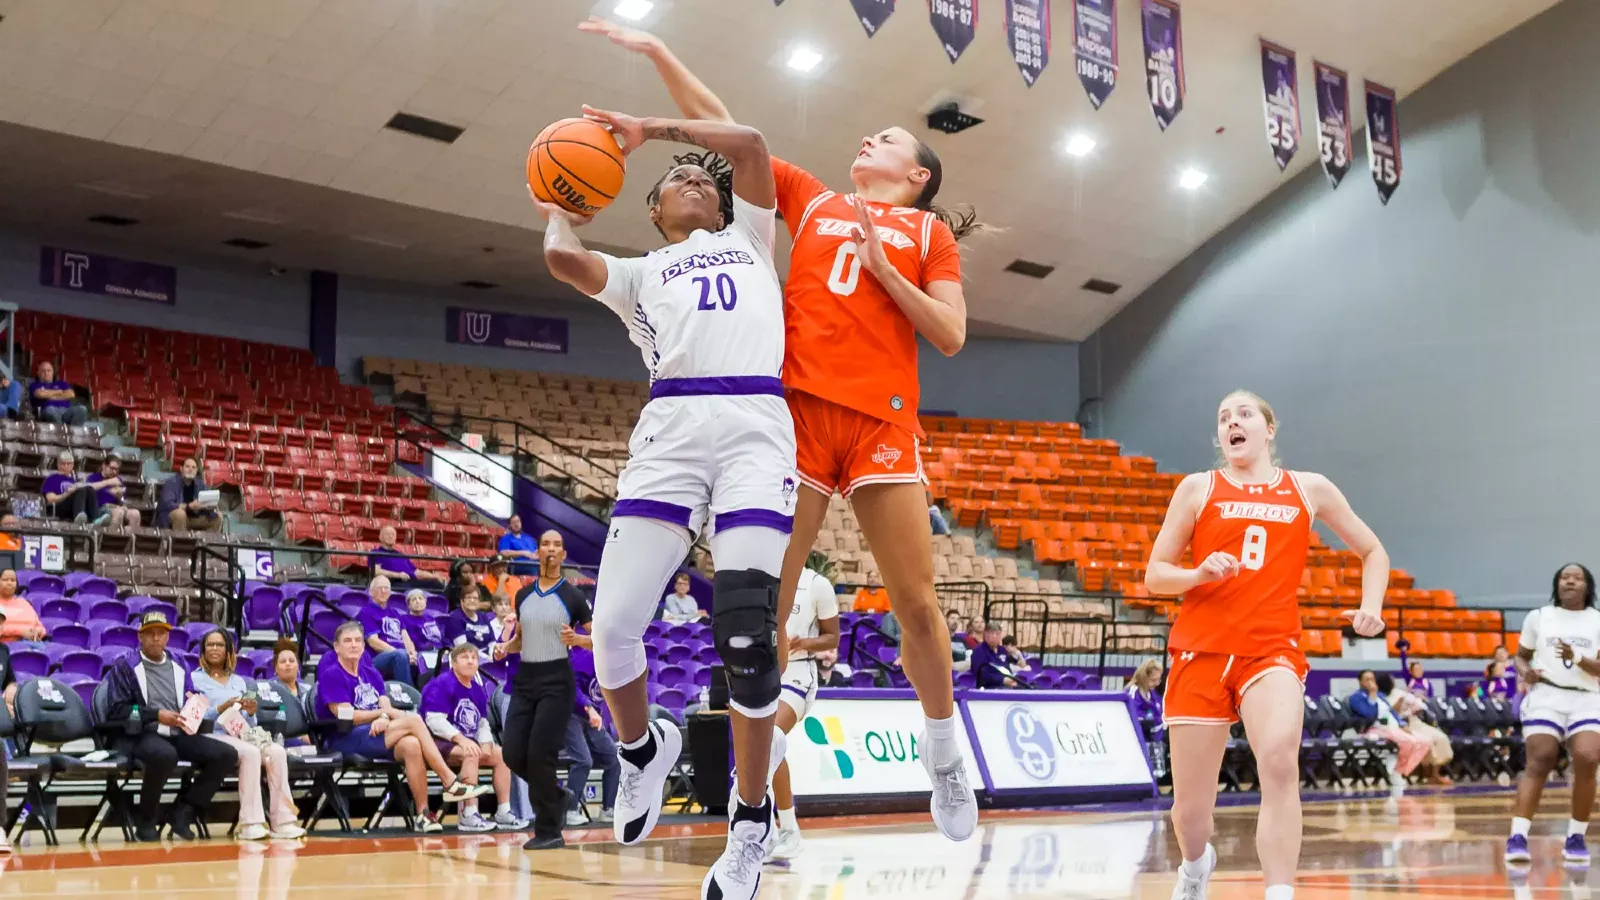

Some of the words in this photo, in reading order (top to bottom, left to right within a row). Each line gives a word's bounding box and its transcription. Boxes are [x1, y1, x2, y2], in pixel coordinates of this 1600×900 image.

[1150, 74, 1177, 109] 10
[1266, 116, 1295, 150] 25
[64, 252, 90, 288] T
[660, 250, 754, 287] DEMONS
[827, 240, 862, 297] 0
[691, 272, 738, 312] 20
[465, 312, 491, 343] U
[1214, 501, 1300, 524] UTRGV
[1241, 525, 1268, 571] 8
[256, 556, 273, 577] G
[1055, 720, 1108, 755] Graf
